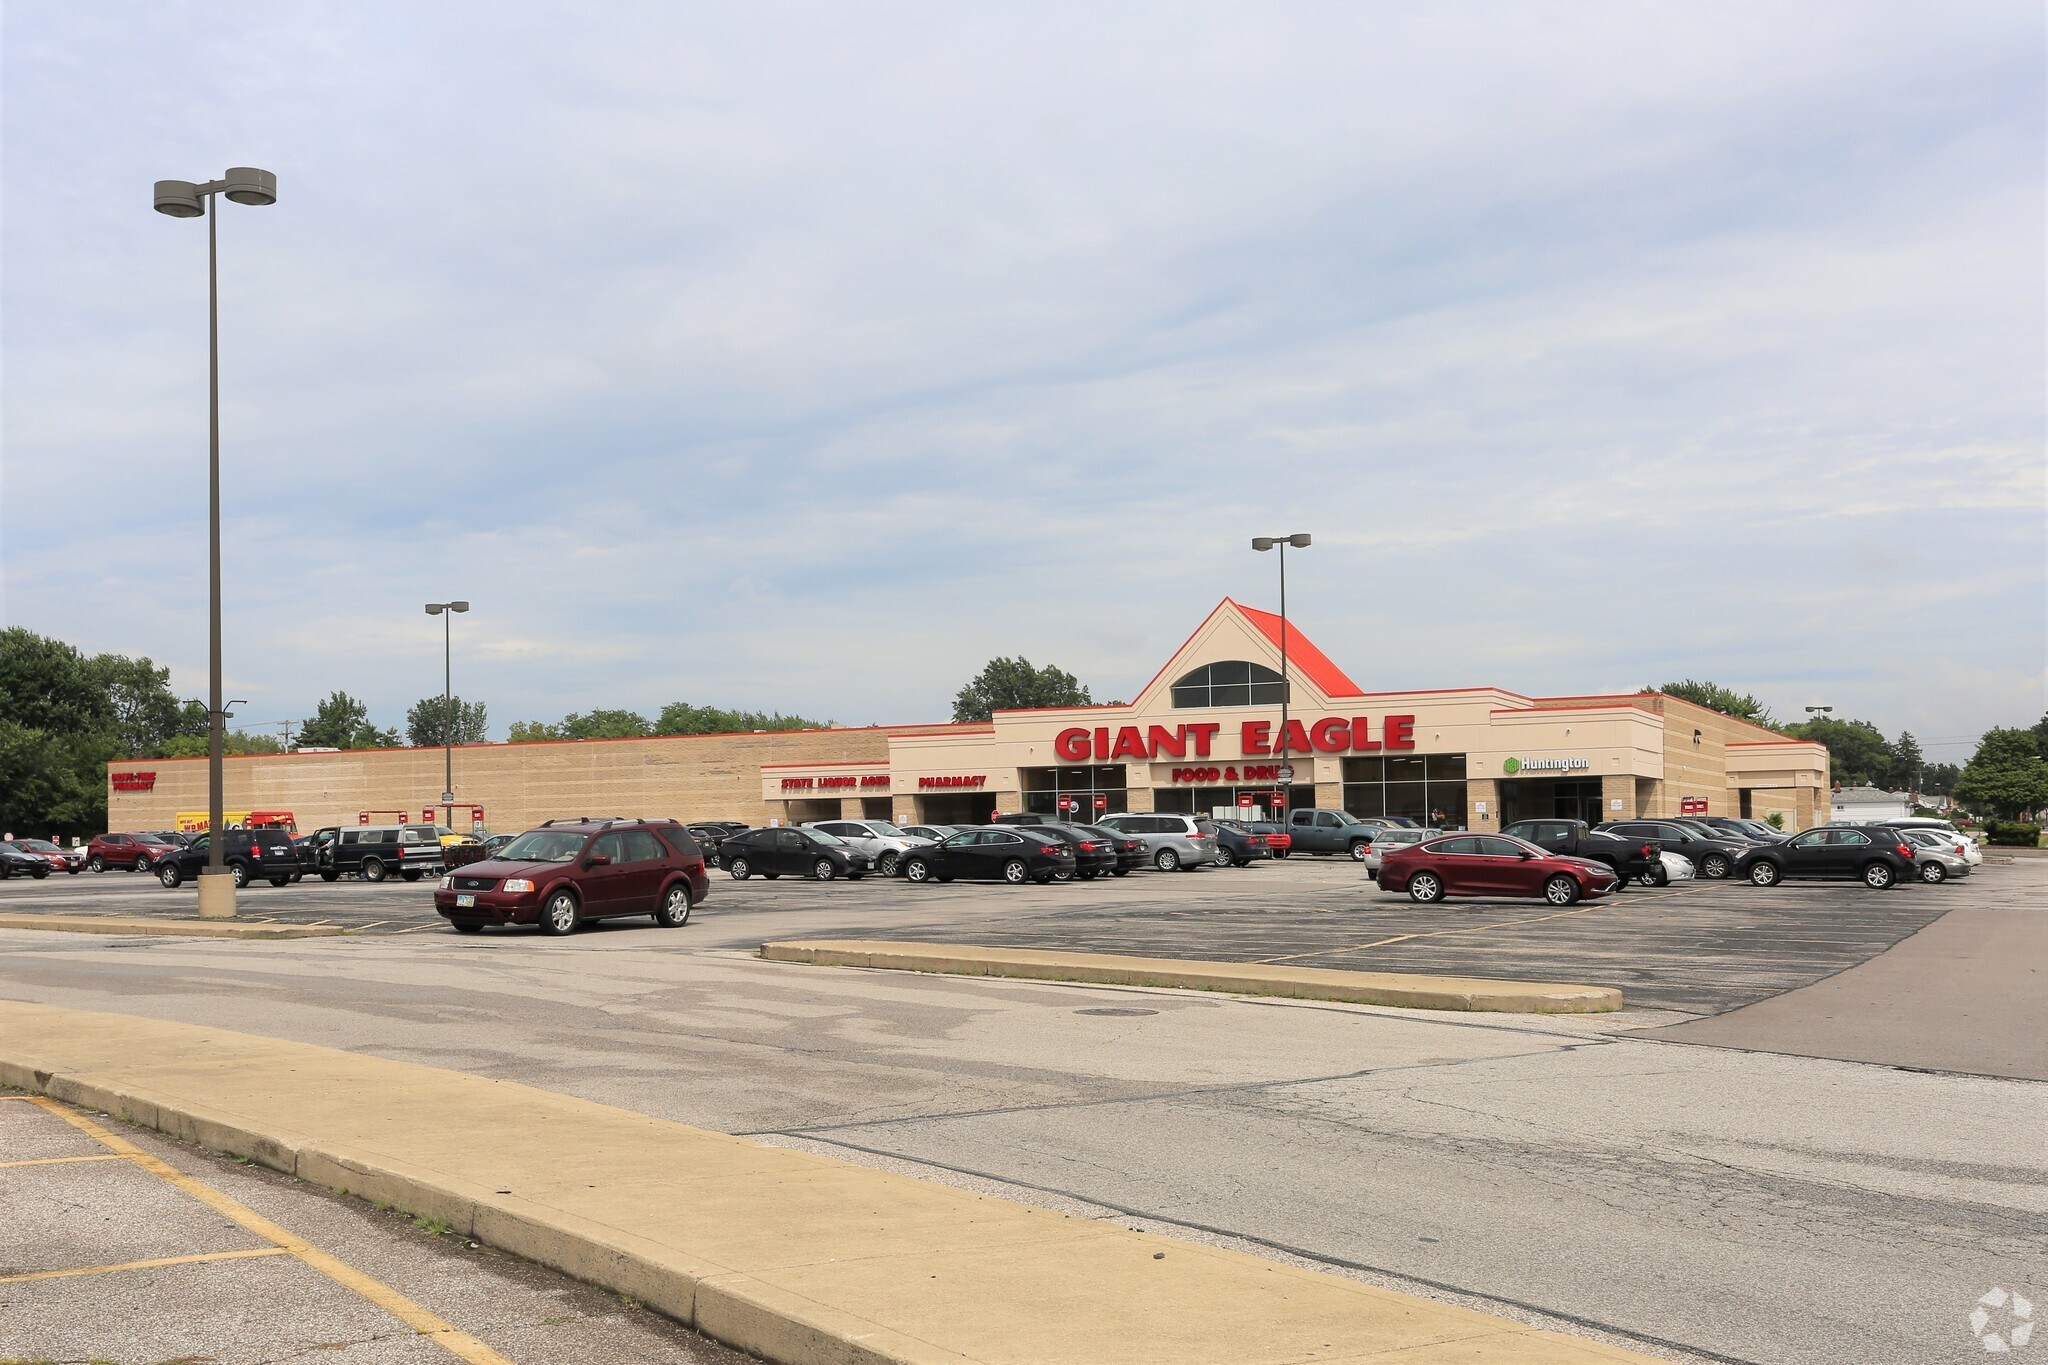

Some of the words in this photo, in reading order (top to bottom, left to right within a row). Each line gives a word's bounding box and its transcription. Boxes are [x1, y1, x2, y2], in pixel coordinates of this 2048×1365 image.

[1055, 722, 1220, 761] GIANT
[1241, 714, 1415, 754] EAGLE
[1521, 757, 1589, 772] Huntington
[918, 775, 987, 788] PHARMACY
[1172, 767, 1220, 782] FOOD
[1224, 766, 1239, 781] &
[781, 778, 813, 789] STATE
[817, 777, 857, 788] LIQUOR
